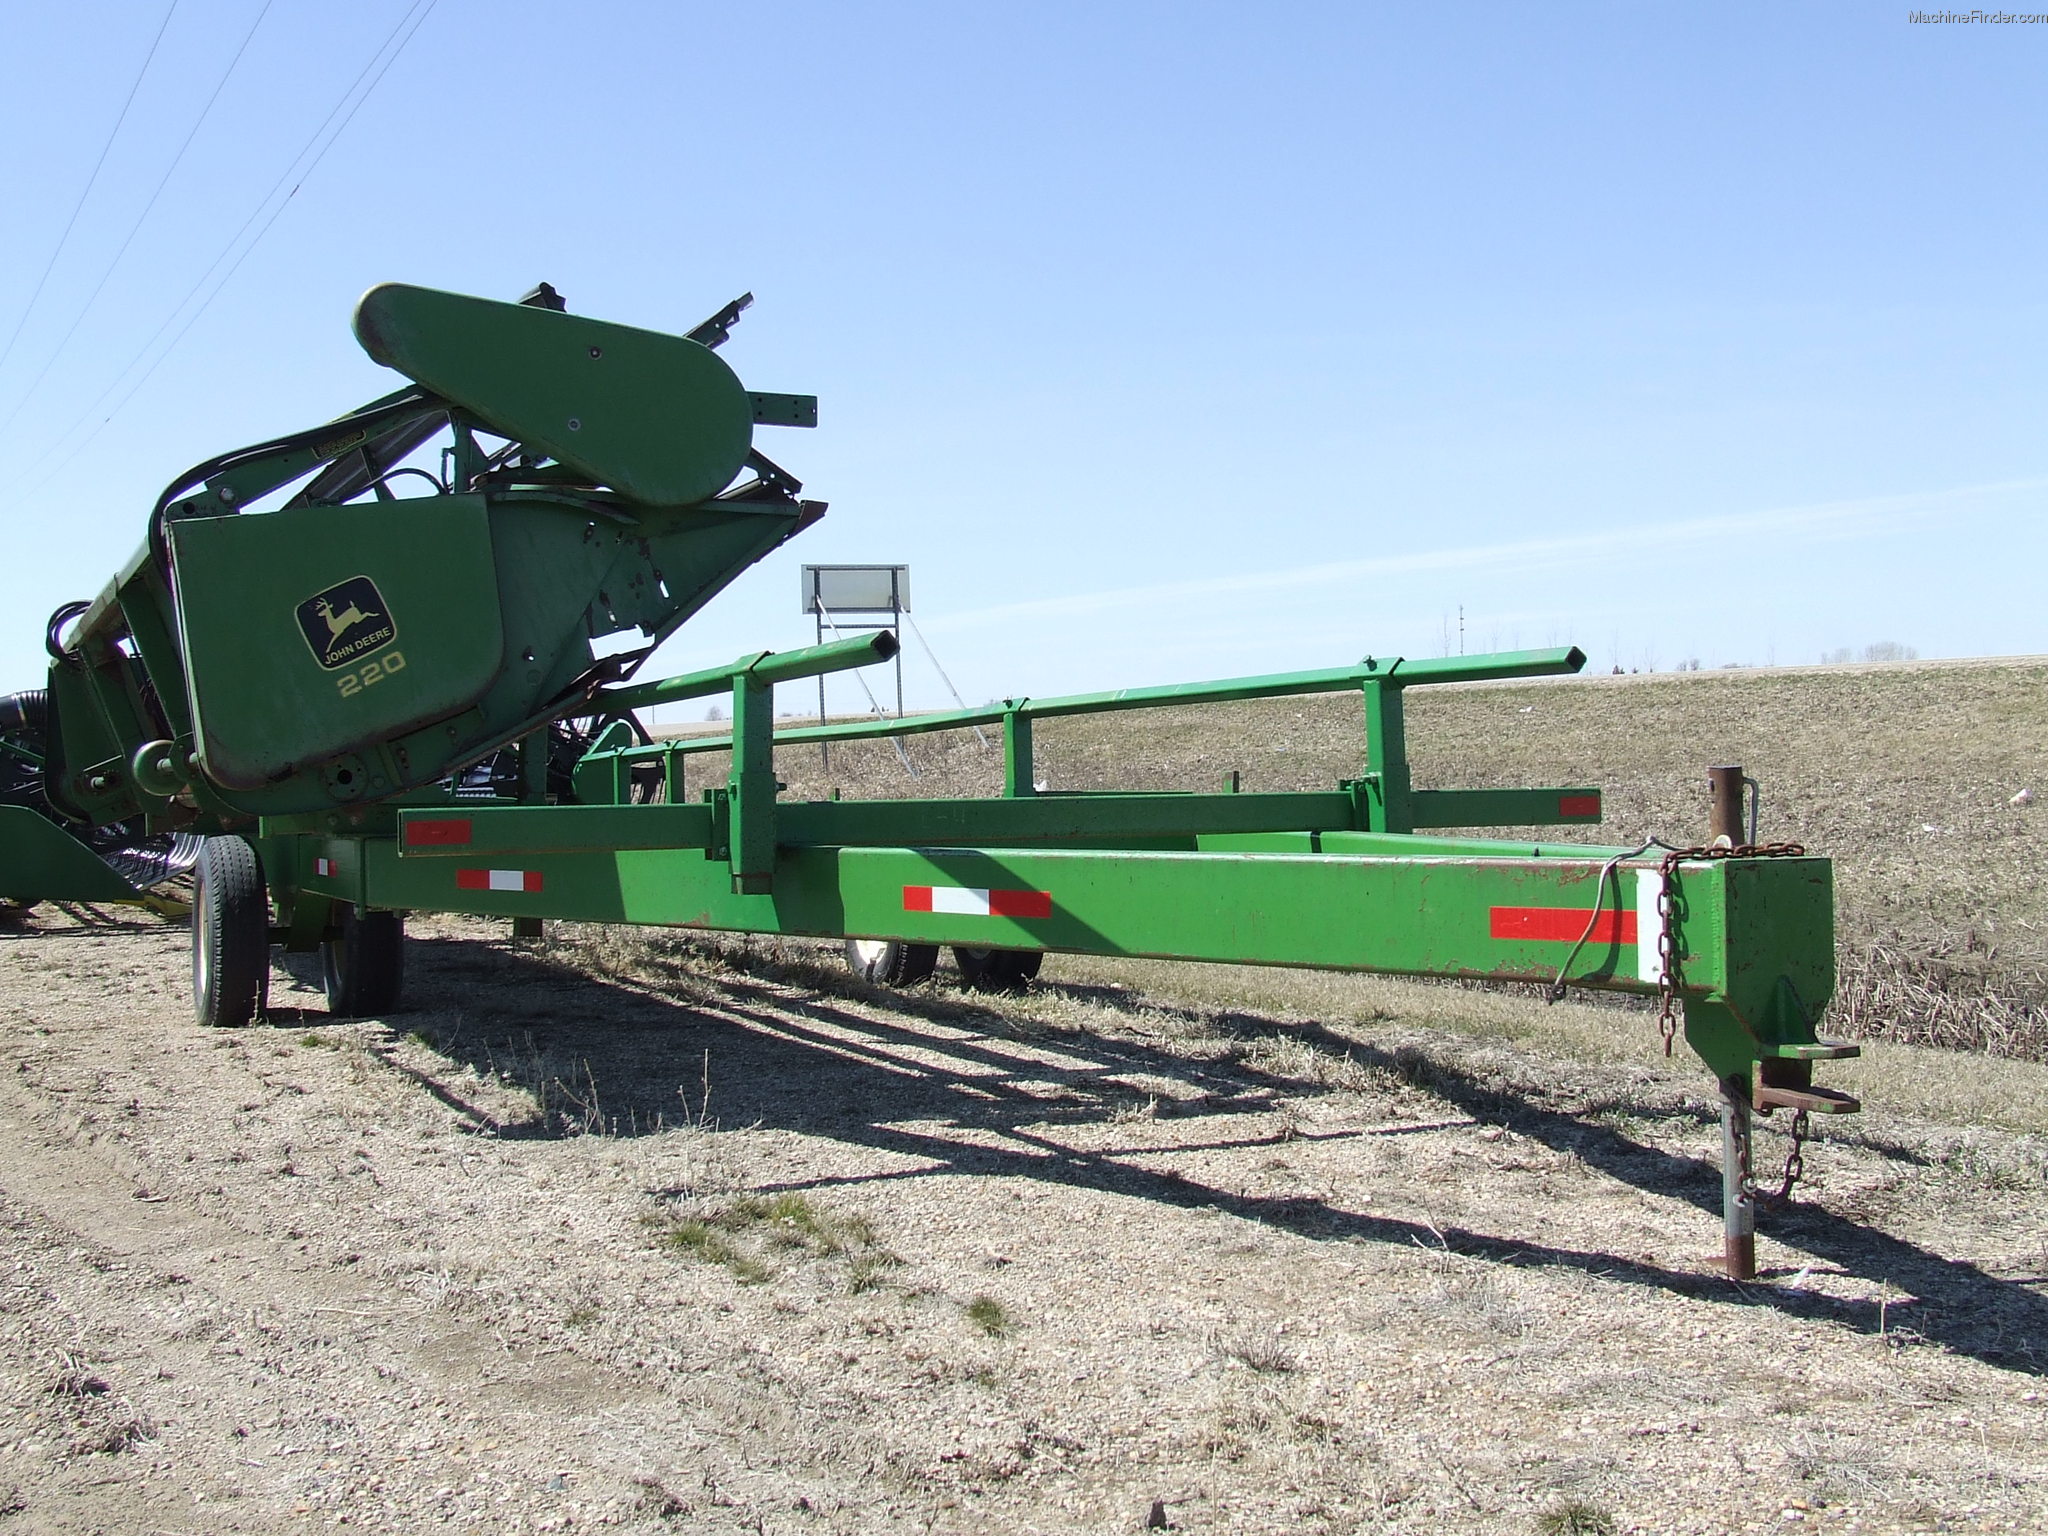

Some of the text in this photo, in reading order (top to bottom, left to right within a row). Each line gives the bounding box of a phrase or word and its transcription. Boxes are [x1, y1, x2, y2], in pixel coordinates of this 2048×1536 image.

[325, 626, 391, 665] JOHN DEERE
[337, 651, 406, 697] 220
